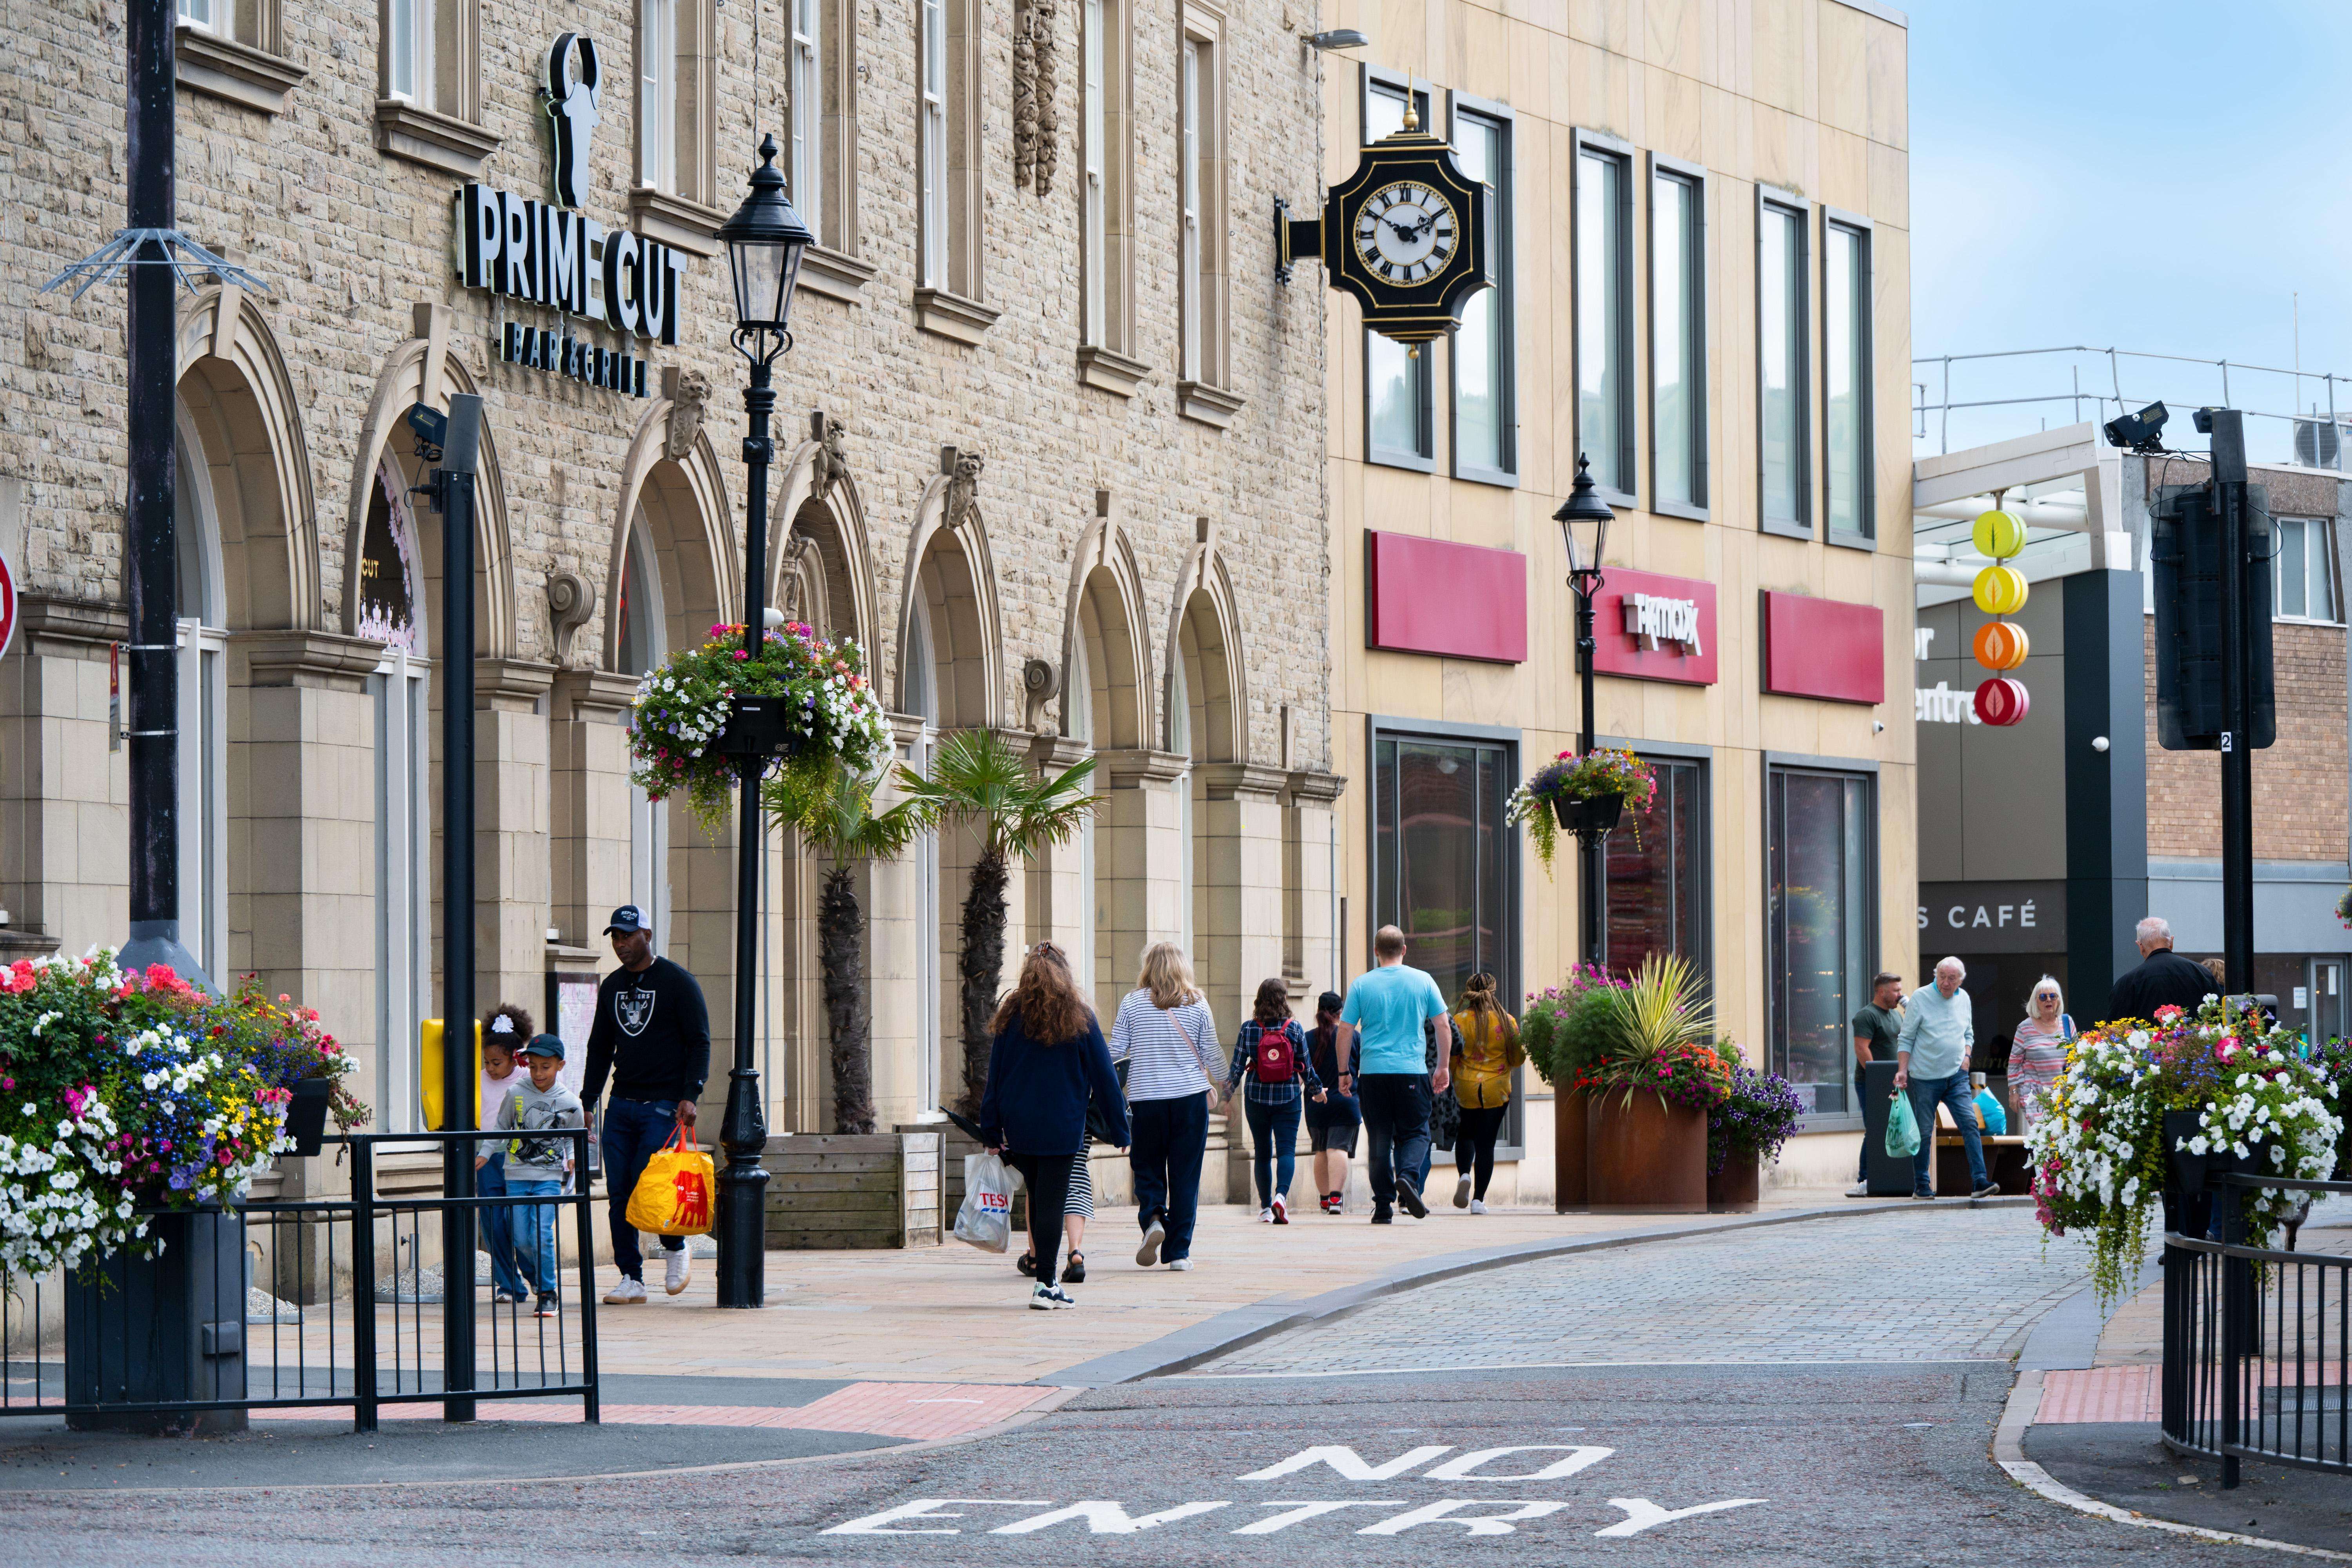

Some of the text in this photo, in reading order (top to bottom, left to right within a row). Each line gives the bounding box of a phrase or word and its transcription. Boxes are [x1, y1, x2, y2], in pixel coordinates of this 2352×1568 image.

[463, 184, 687, 347] PRIME CUT
[501, 322, 651, 398] BAR & GRILL
[362, 557, 379, 578] CUT
[2222, 734, 2230, 748] 2
[1918, 898, 2036, 929] S CAFÉ
[1235, 1445, 1617, 1482] NO
[817, 1498, 1770, 1537] ENTRY
